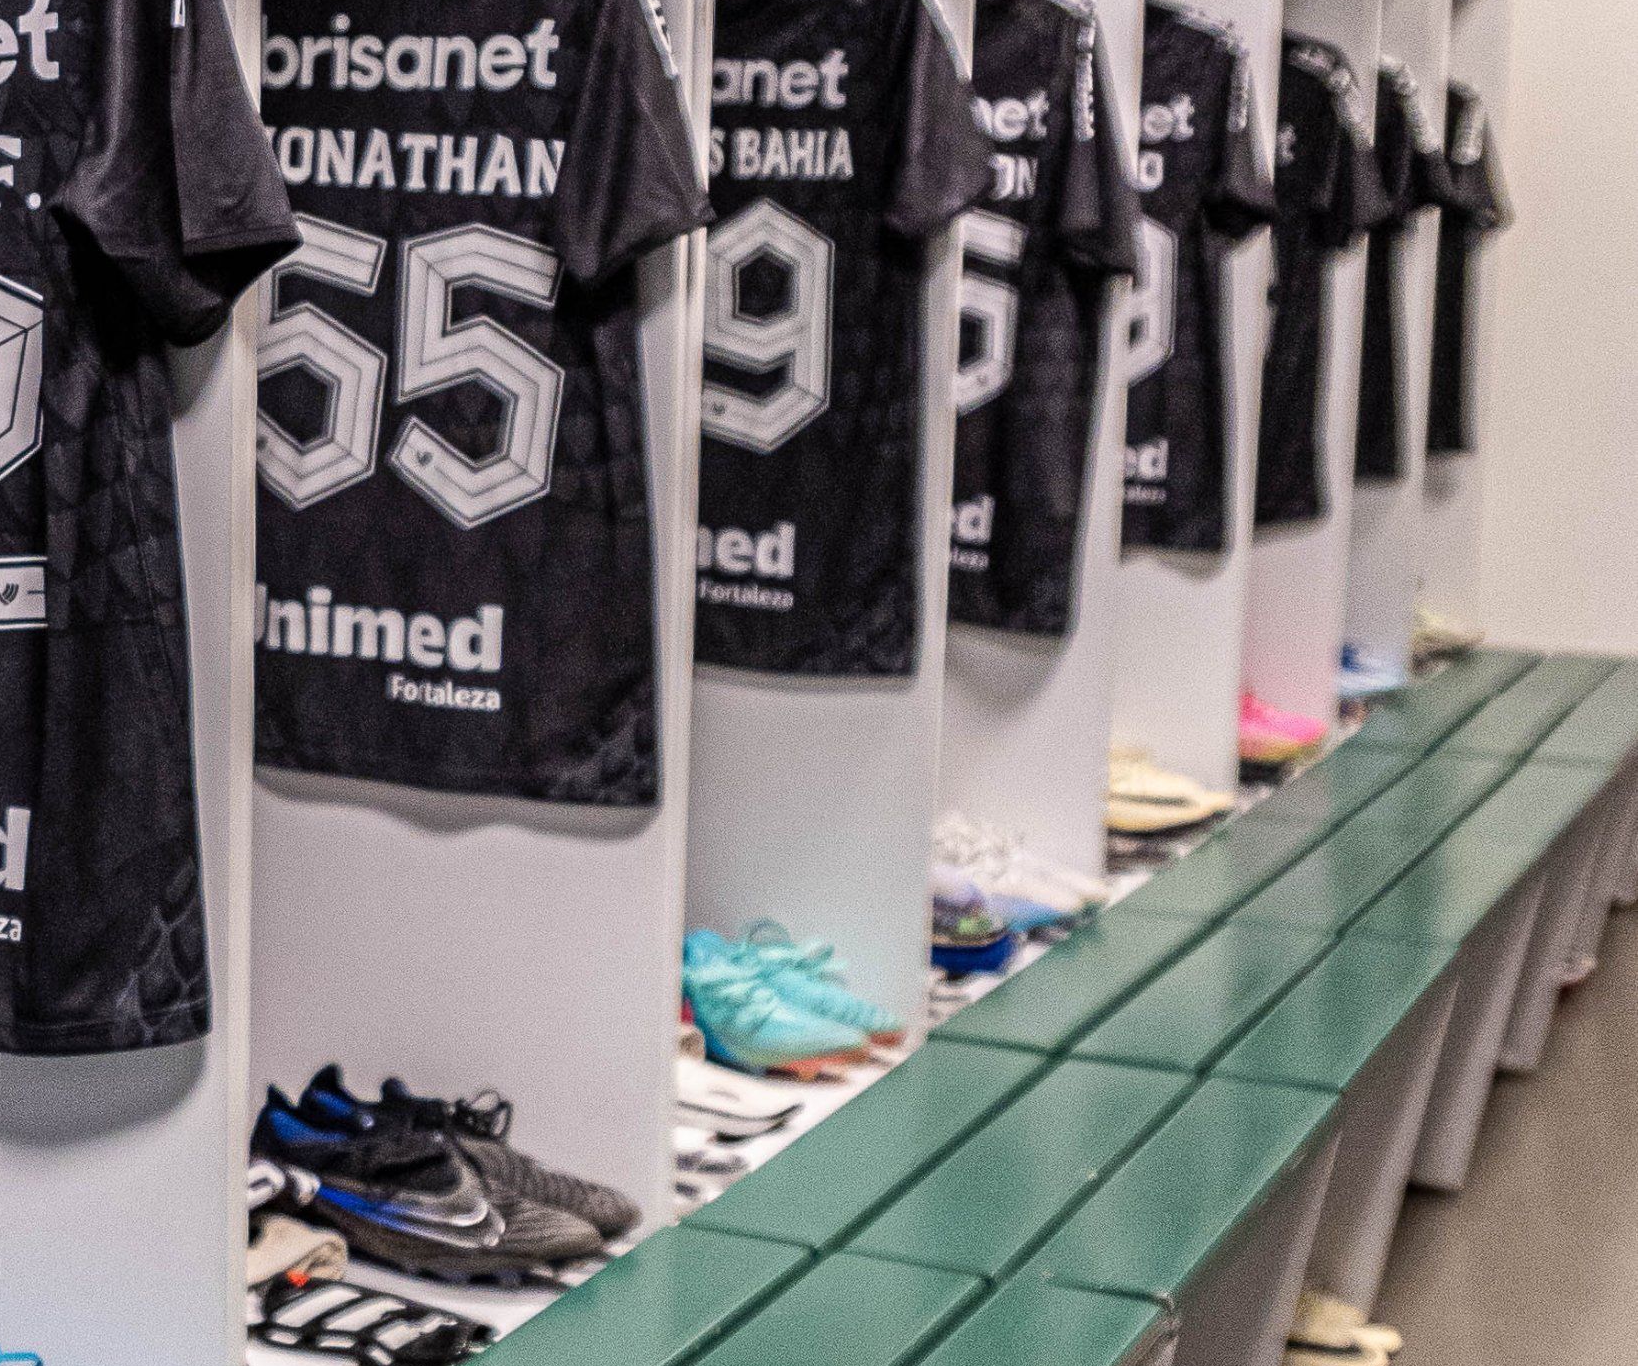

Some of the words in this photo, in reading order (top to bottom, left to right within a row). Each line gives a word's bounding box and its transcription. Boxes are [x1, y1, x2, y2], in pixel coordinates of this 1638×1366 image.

[712, 49, 850, 108] anet
[264, 124, 566, 198] ONATHAN
[732, 128, 854, 179] BAHIA
[700, 196, 835, 455] 9
[389, 671, 502, 712] Fortaleza
